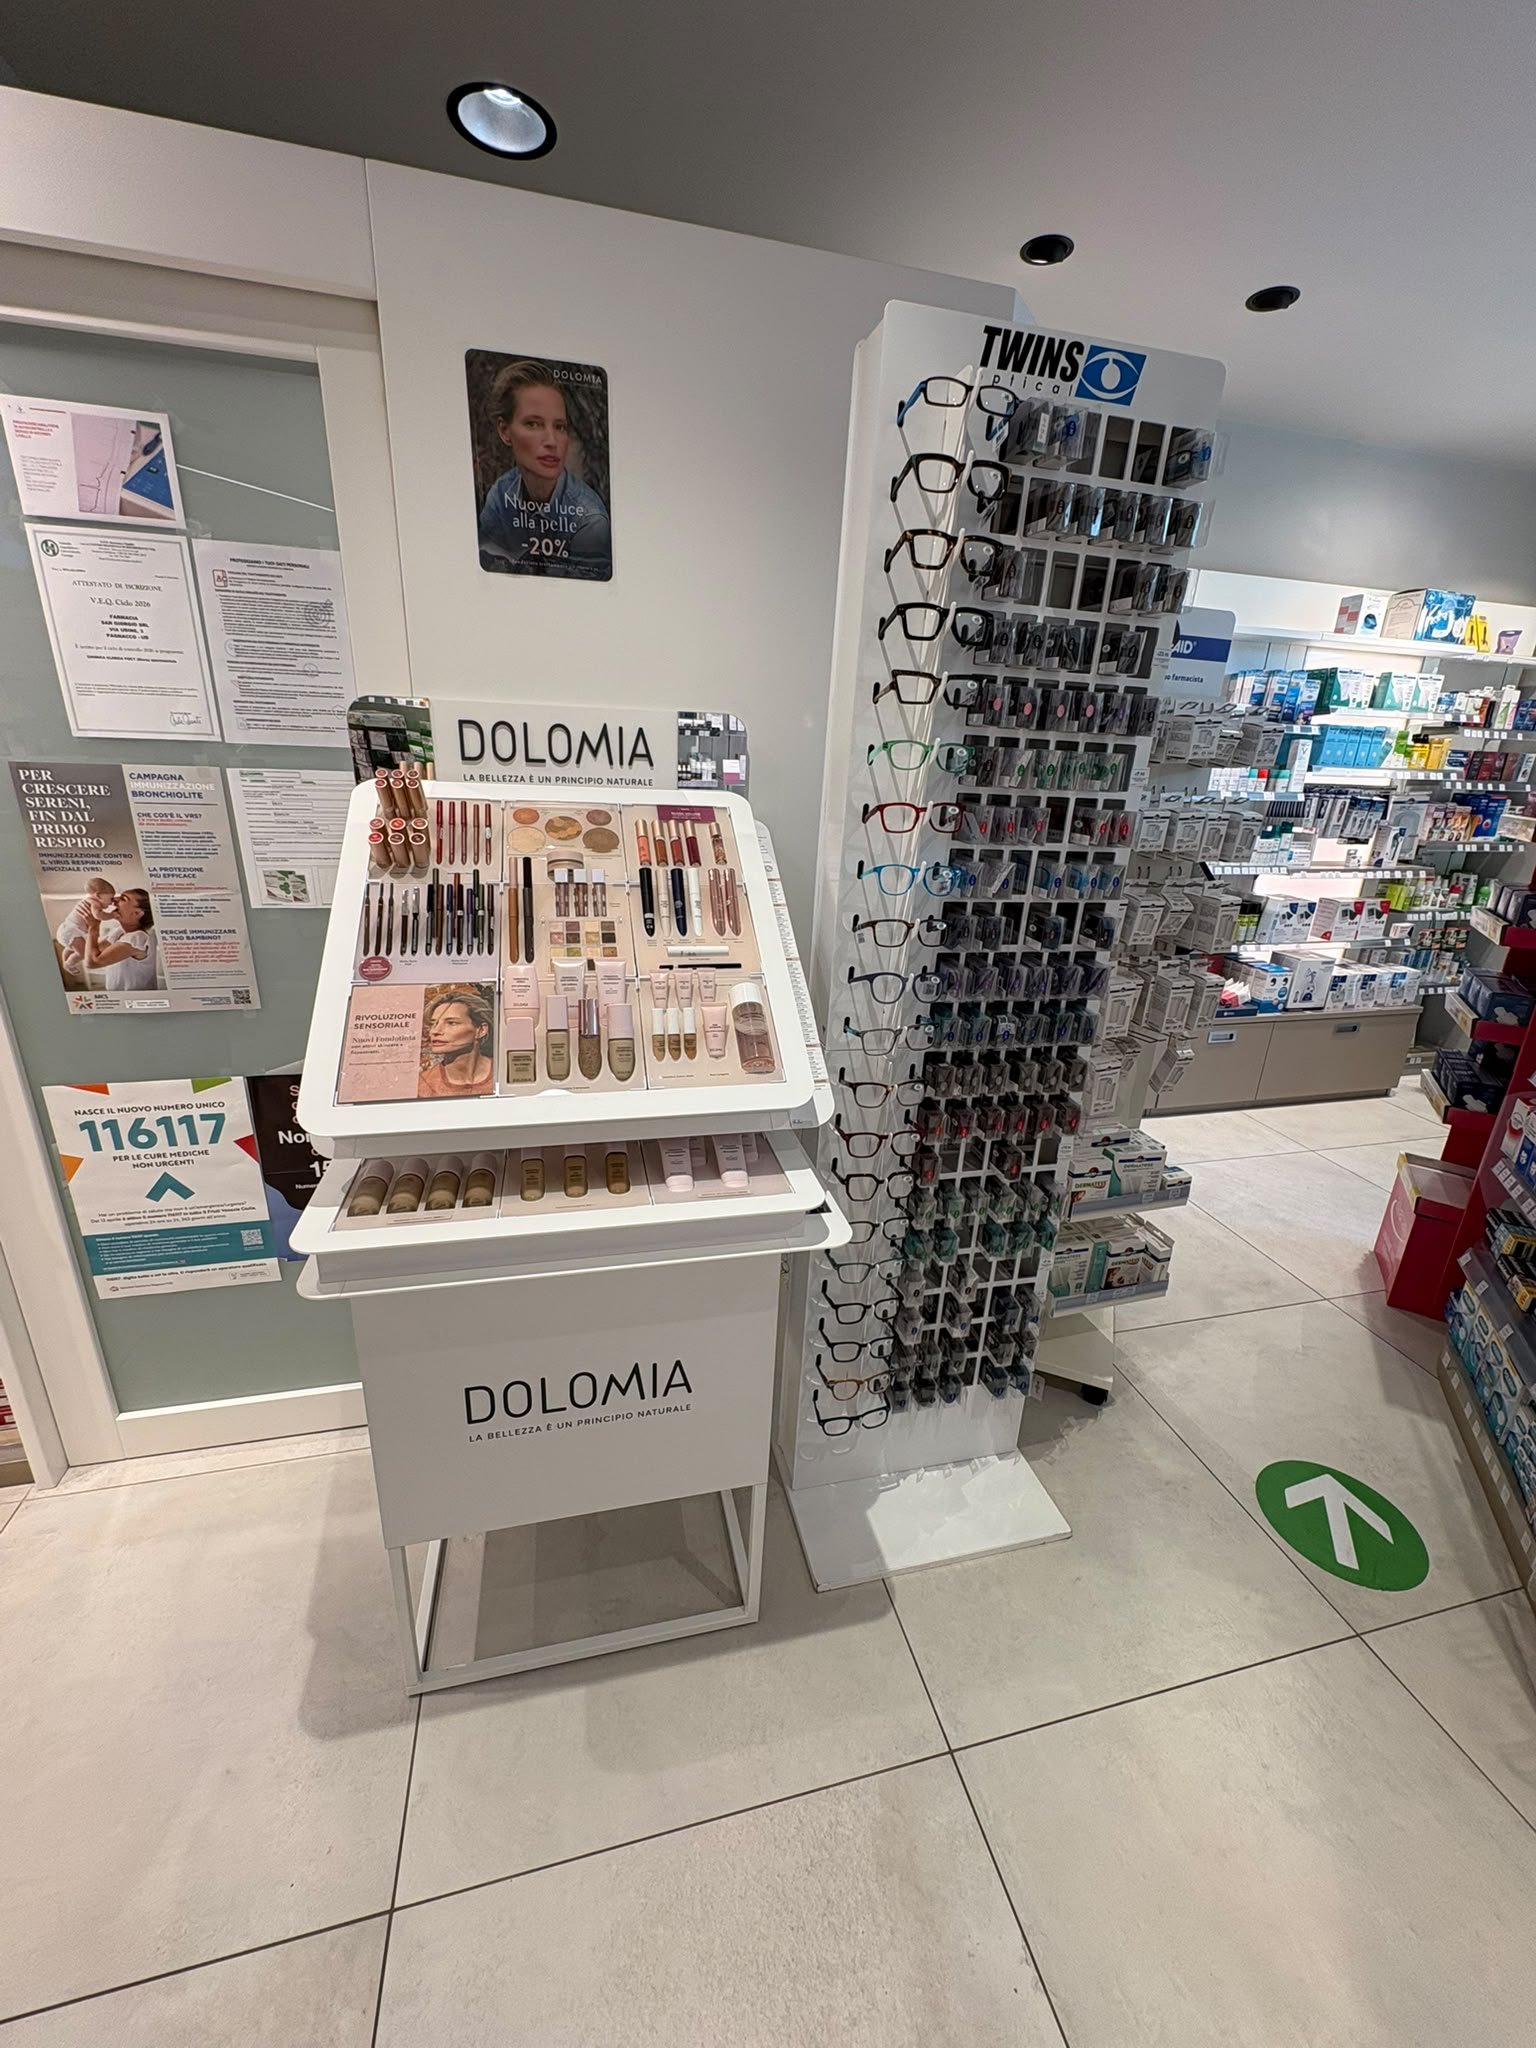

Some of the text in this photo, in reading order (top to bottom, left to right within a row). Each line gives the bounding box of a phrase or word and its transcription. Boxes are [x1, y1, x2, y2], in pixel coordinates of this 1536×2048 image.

[979, 325, 1085, 382] TWINS
[554, 369, 602, 384] DOLOMIA
[980, 373, 1073, 397] ptical
[504, 492, 584, 517] Nuova luce
[512, 513, 577, 533] alla pelle
[521, 537, 569, 558] -20%
[72, 580, 163, 593] ATTESTATO DI ISCRIZIONE
[90, 596, 152, 608] V.E.Q. Ciclo 2026
[1172, 674, 1203, 683] farmacista
[458, 719, 654, 768] DOLOMIA
[18, 769, 54, 781] PER
[129, 772, 185, 781] CAMPAGNA
[463, 773, 654, 787] LA BELLEZZA È UN PRINCIPIO NATURALE
[22, 783, 111, 796] CRESCERE
[130, 781, 215, 791] IMMUNIZZAZIONE
[131, 790, 204, 799] BRONCHIOLITE
[25, 797, 91, 810] SERENI,
[28, 810, 95, 822] FIN DAL
[32, 824, 87, 835] PRIMO
[35, 837, 106, 848] RESPIRO
[355, 1013, 416, 1021] RIVOLUZIONE
[74, 1108, 105, 1116] NASCE
[117, 1105, 152, 1113] NUOVO
[153, 1103, 194, 1111] NUMERO
[195, 1101, 225, 1109] UNICO
[79, 1113, 226, 1152] 116117
[143, 1152, 168, 1160] CURE
[169, 1149, 210, 1158] MEDICHE
[155, 1159, 194, 1168] URGENTI
[464, 1360, 692, 1425] DOLOMIA
[469, 1404, 692, 1443] LA BELLEZZA È UN PRINCIPIO NATURALE
